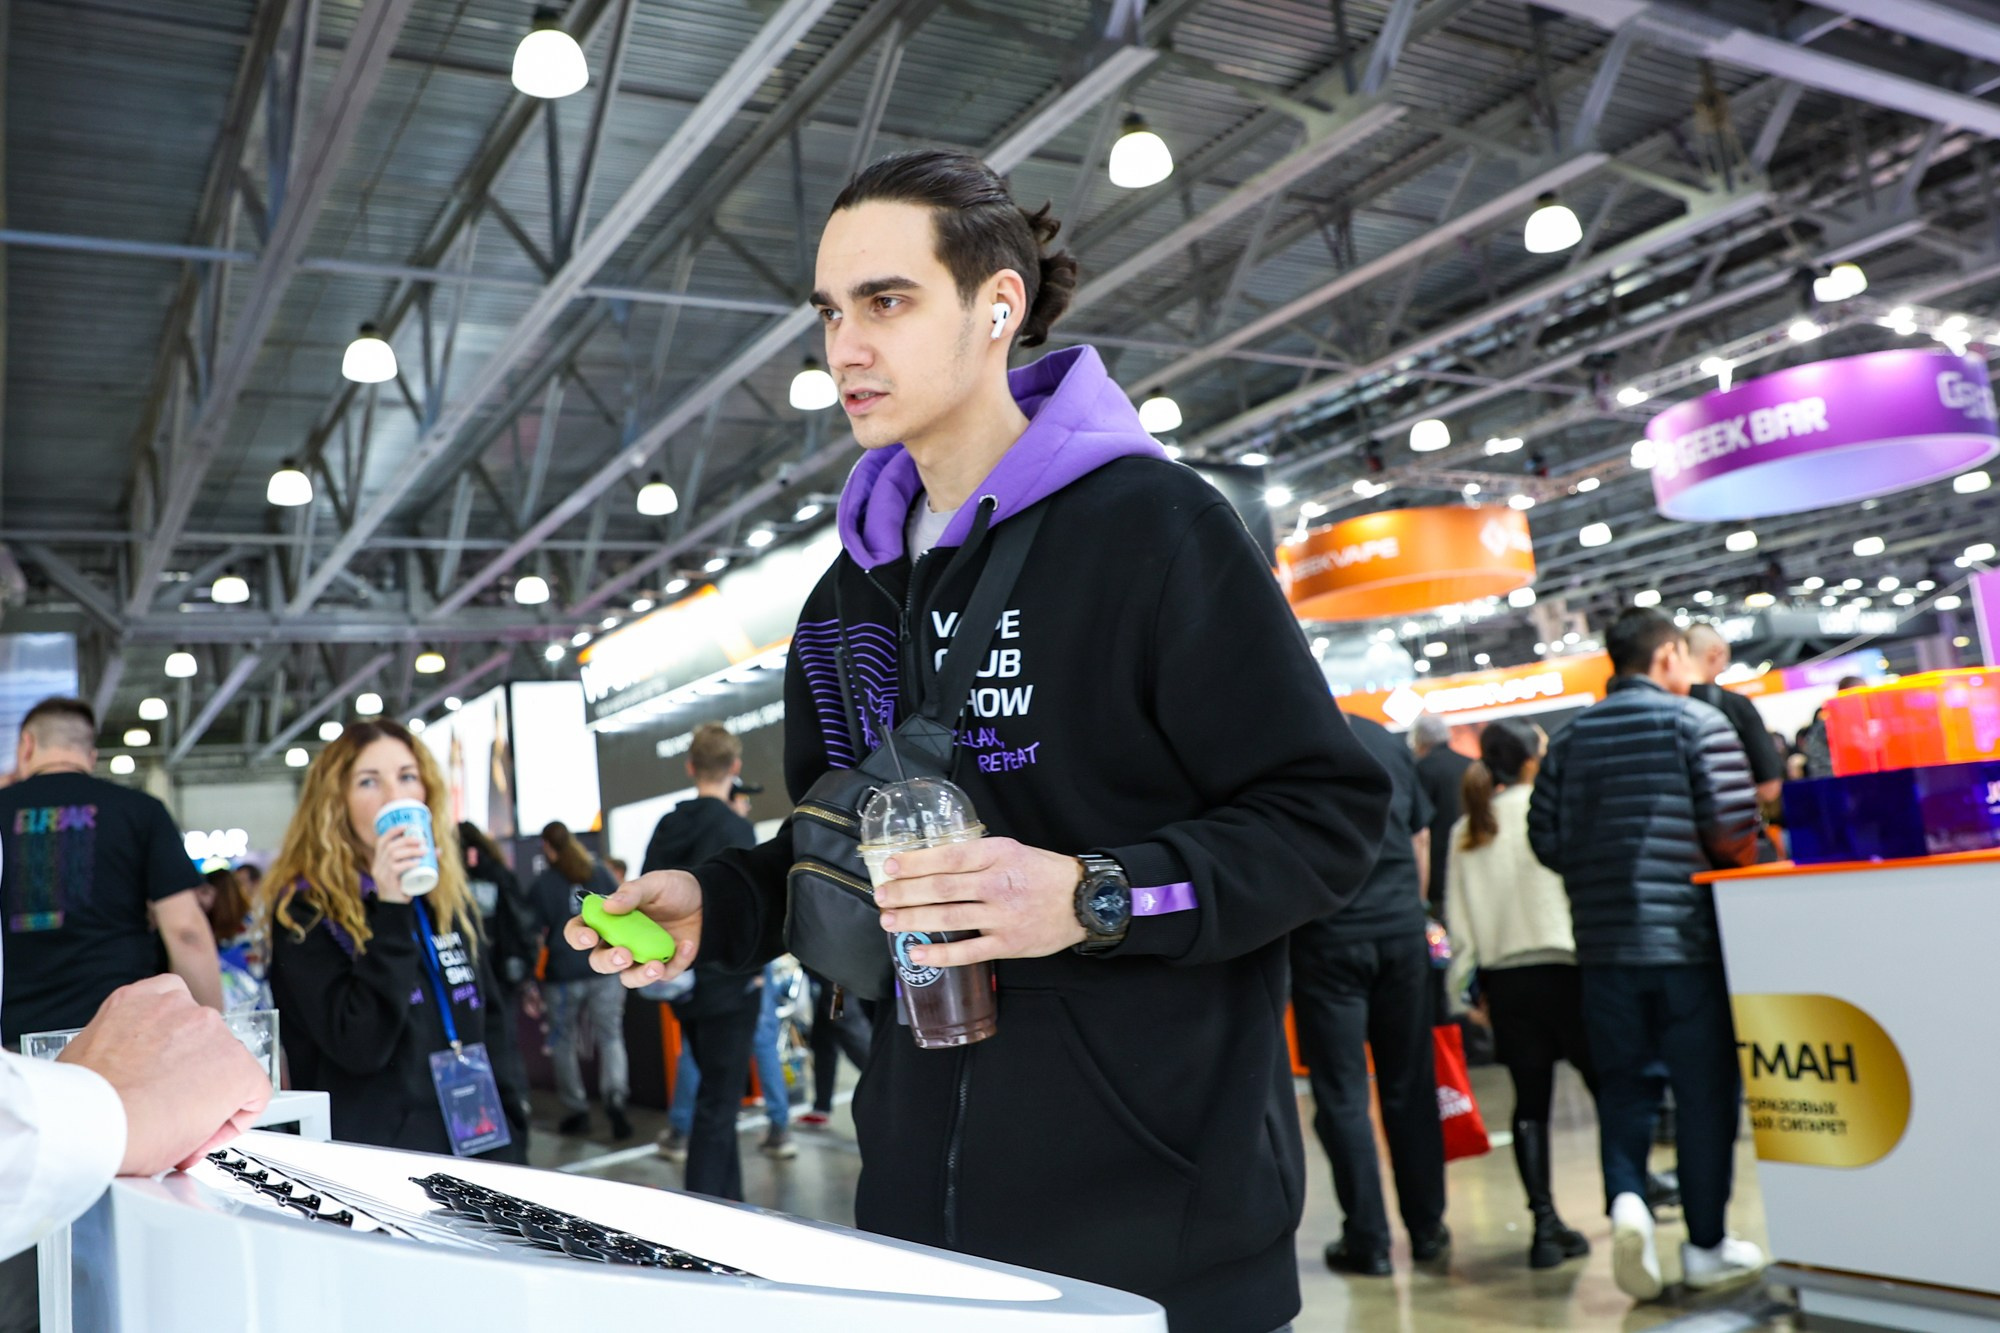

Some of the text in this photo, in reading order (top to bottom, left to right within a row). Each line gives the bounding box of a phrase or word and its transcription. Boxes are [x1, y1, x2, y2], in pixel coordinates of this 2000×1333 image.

[1750, 396, 1829, 444] BAR
[931, 609, 1021, 639] VE
[934, 648, 1022, 678] CUB
[959, 684, 1034, 718] HOW
[977, 741, 1040, 773] REPEAT
